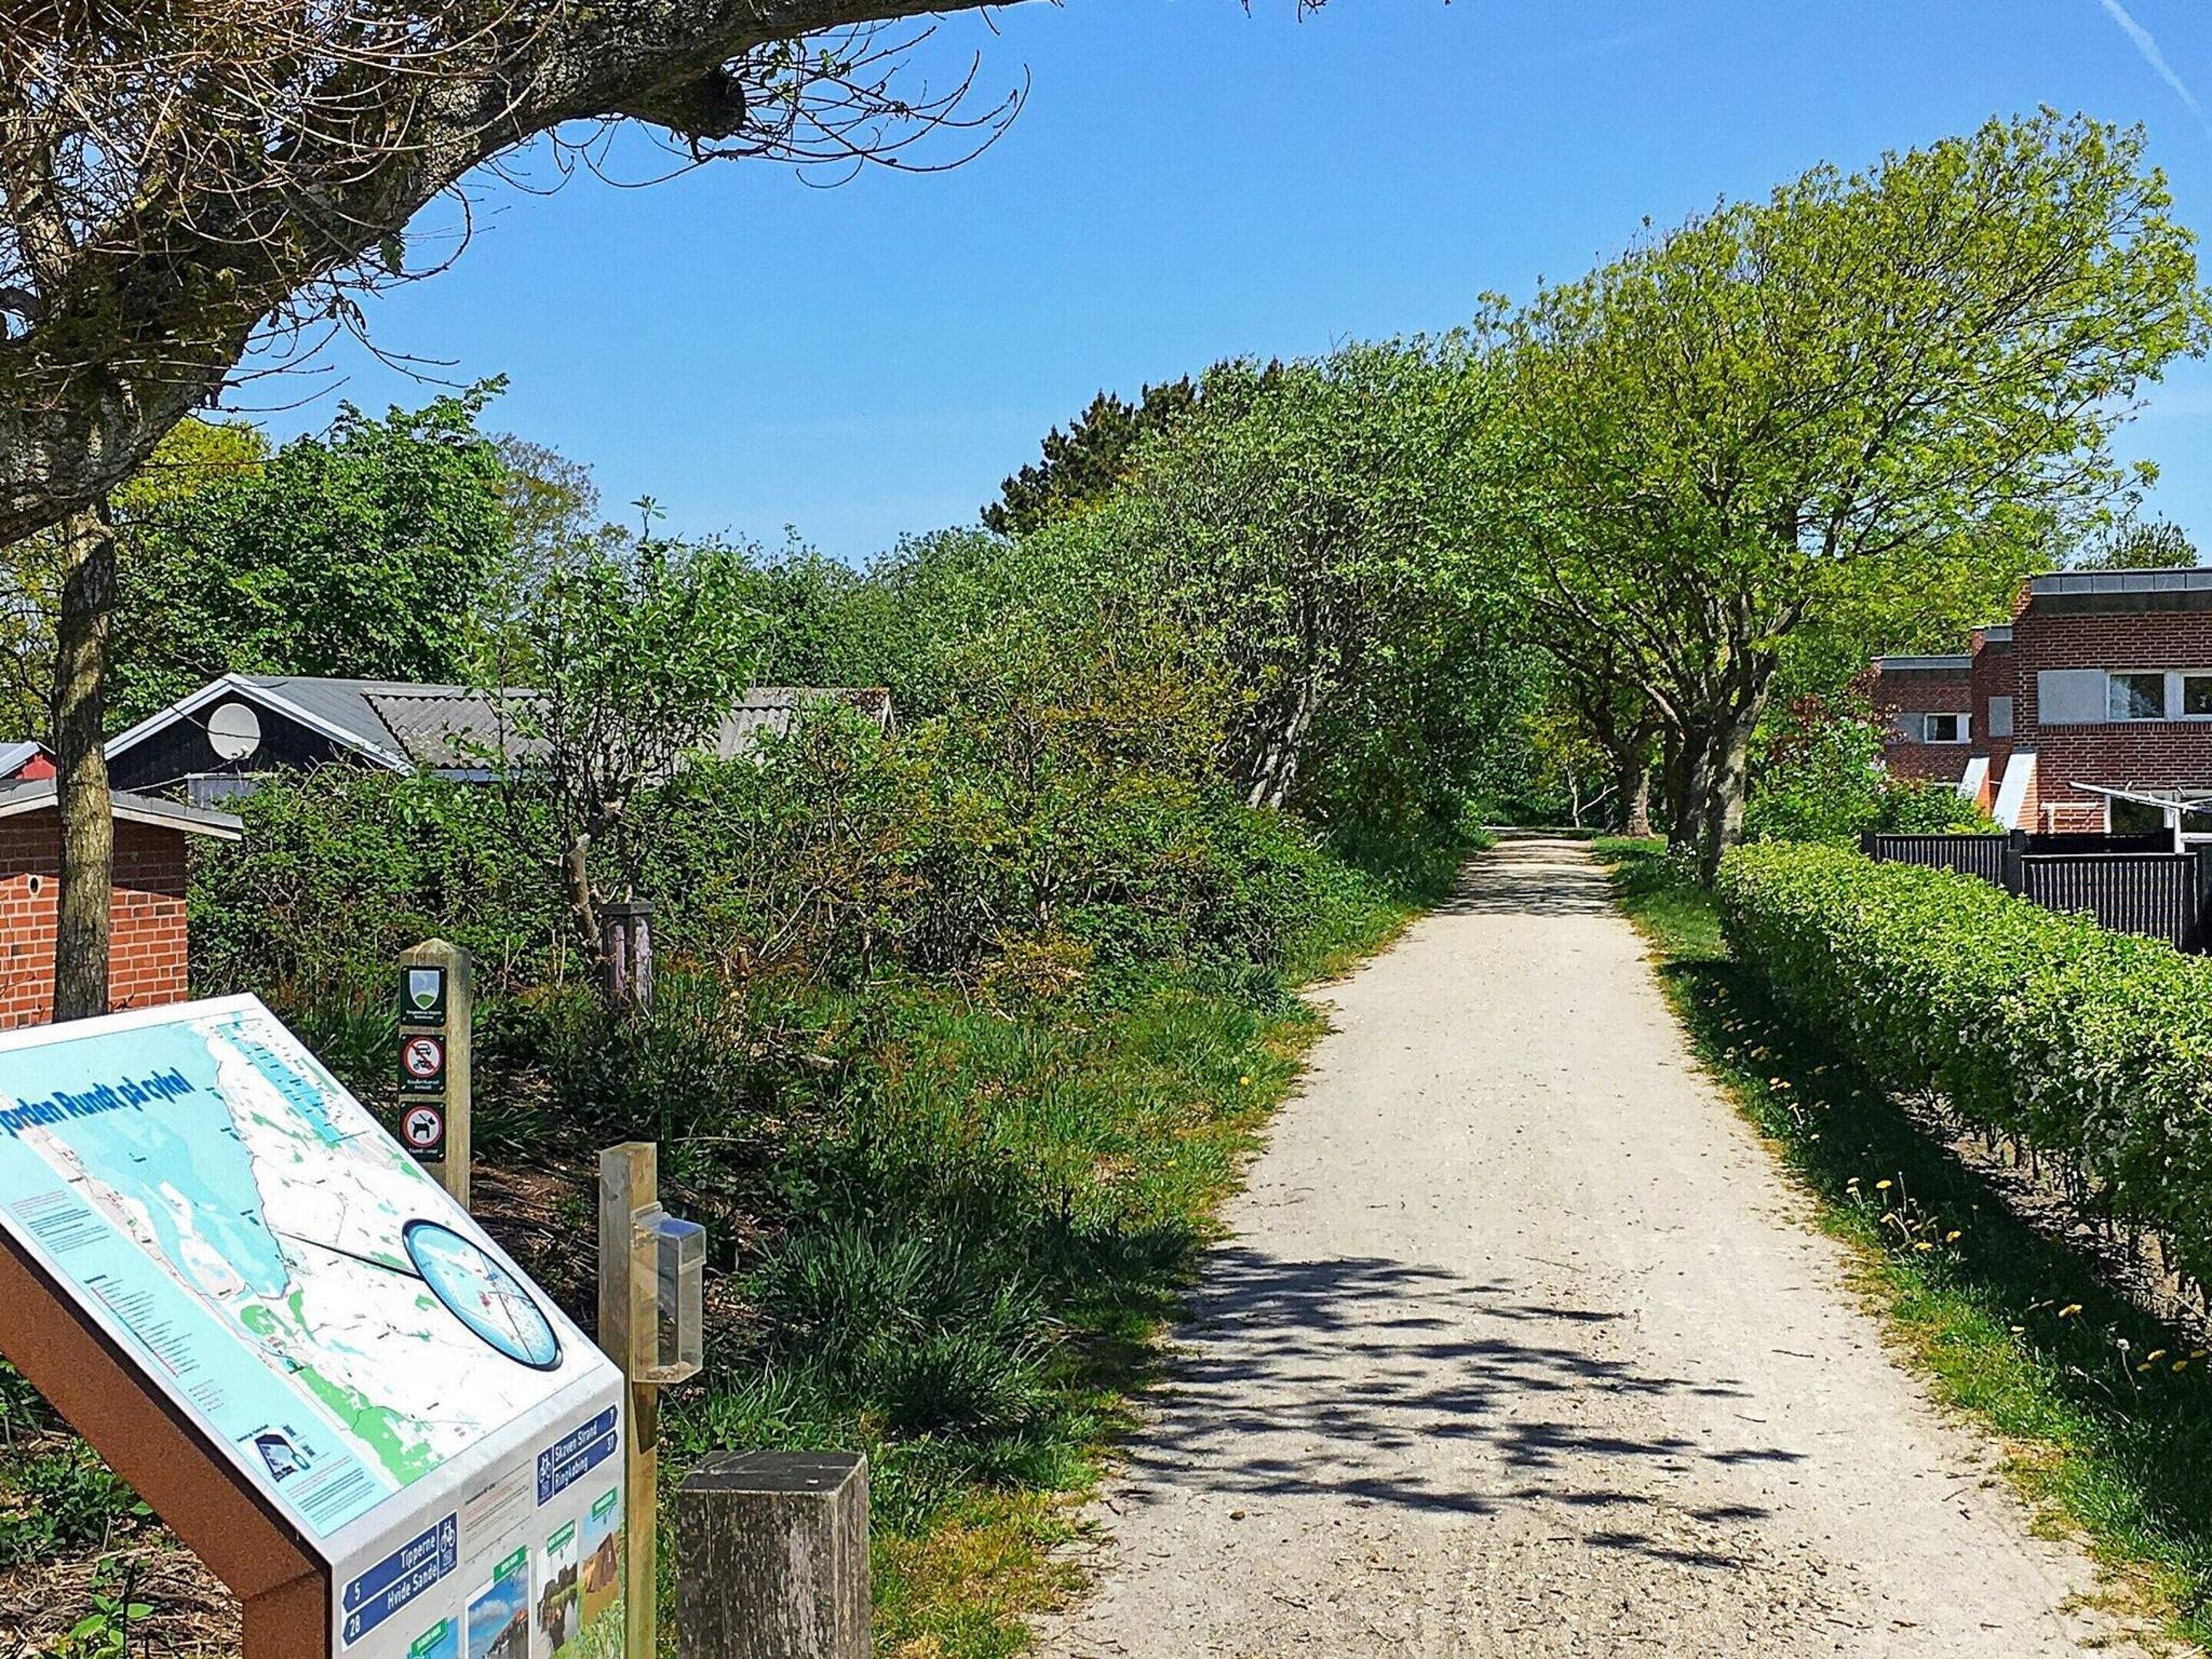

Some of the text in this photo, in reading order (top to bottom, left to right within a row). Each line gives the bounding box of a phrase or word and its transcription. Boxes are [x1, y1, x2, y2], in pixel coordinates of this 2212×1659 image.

[0, 1066, 197, 1139] jorden Rundt på cykel
[578, 1421, 598, 1445] Strand
[349, 1615, 361, 1638] 28
[387, 1582, 411, 1611] Hvide
[412, 1561, 438, 1593] Sande
[354, 1581, 361, 1602] 5
[400, 1534, 435, 1569] Tipperne
